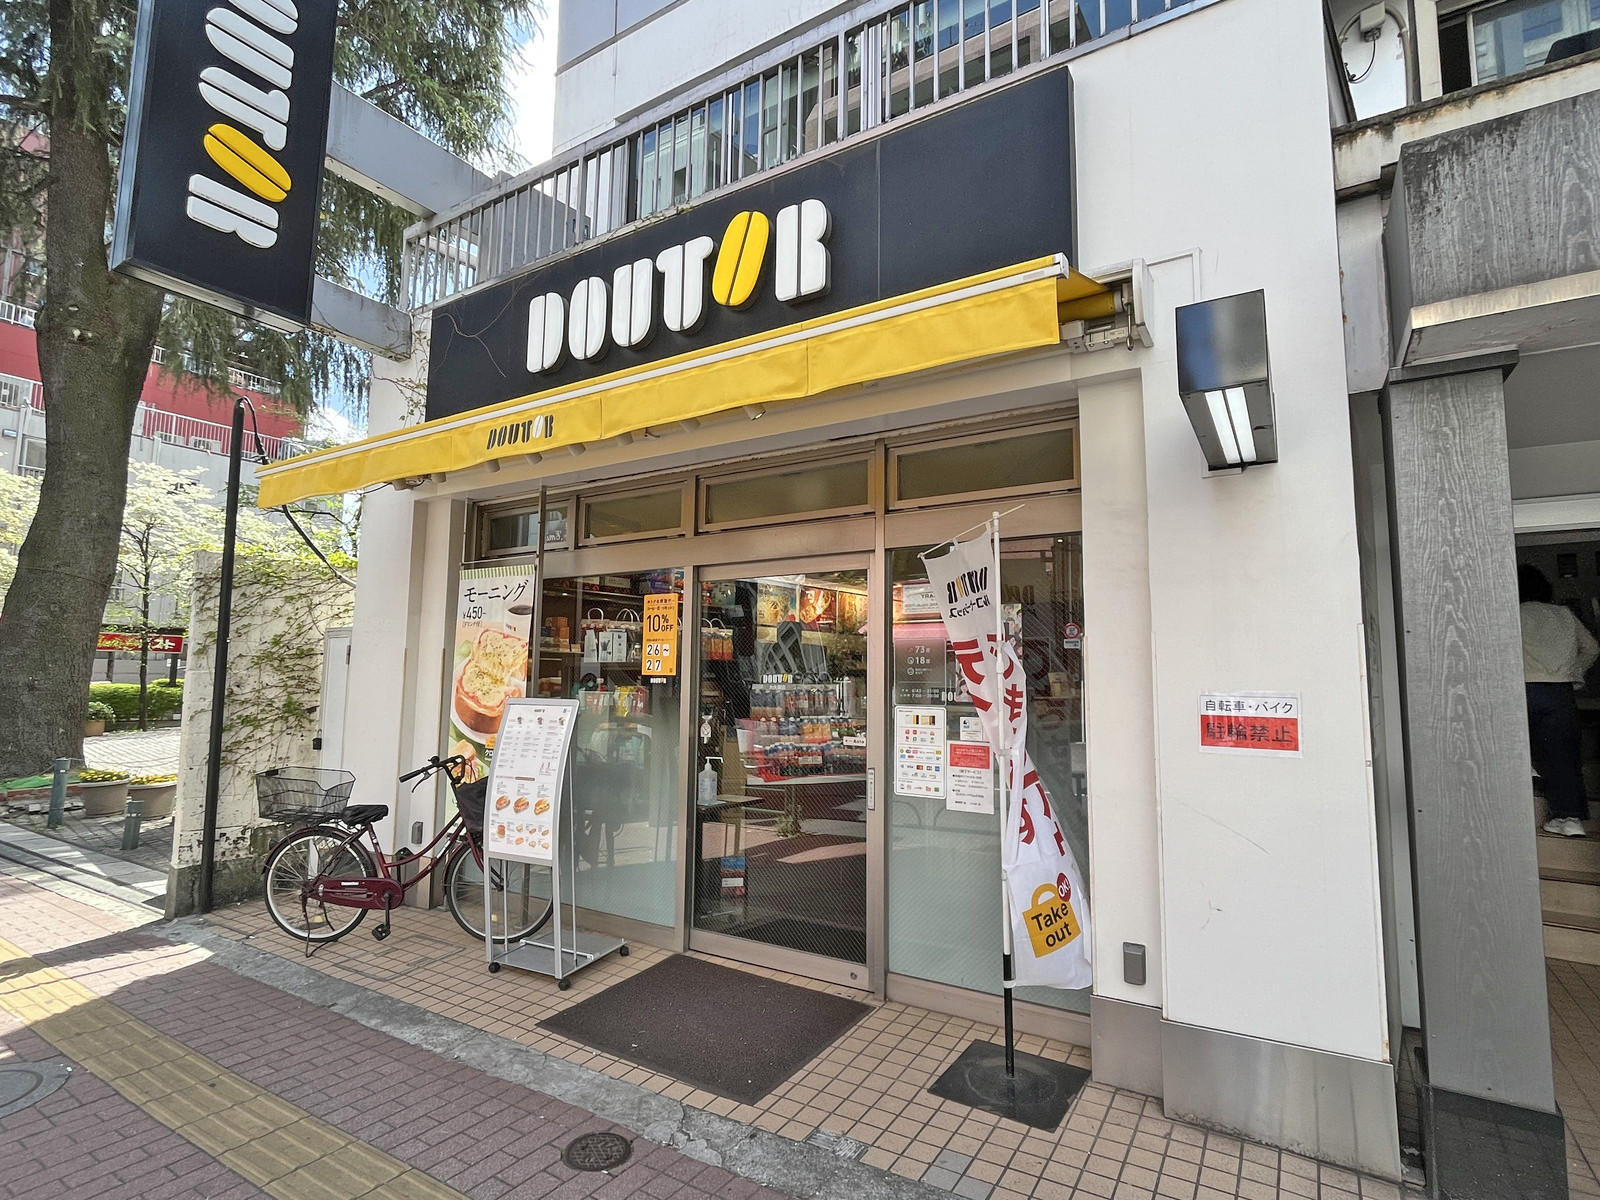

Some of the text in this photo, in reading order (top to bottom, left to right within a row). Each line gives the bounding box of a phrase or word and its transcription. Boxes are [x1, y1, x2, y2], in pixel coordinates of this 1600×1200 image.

[526, 199, 829, 373] DOUTOR
[486, 414, 554, 450] DOUTOR
[463, 579, 529, 602] モーニング
[661, 624, 674, 632] OFF
[646, 659, 661, 671] 27
[1205, 700, 1293, 714] 自転車・バイク
[1206, 722, 1293, 743] 駐輪禁止
[1058, 878, 1071, 897] OK!
[1031, 902, 1069, 932] Take
[1045, 921, 1072, 947] out
